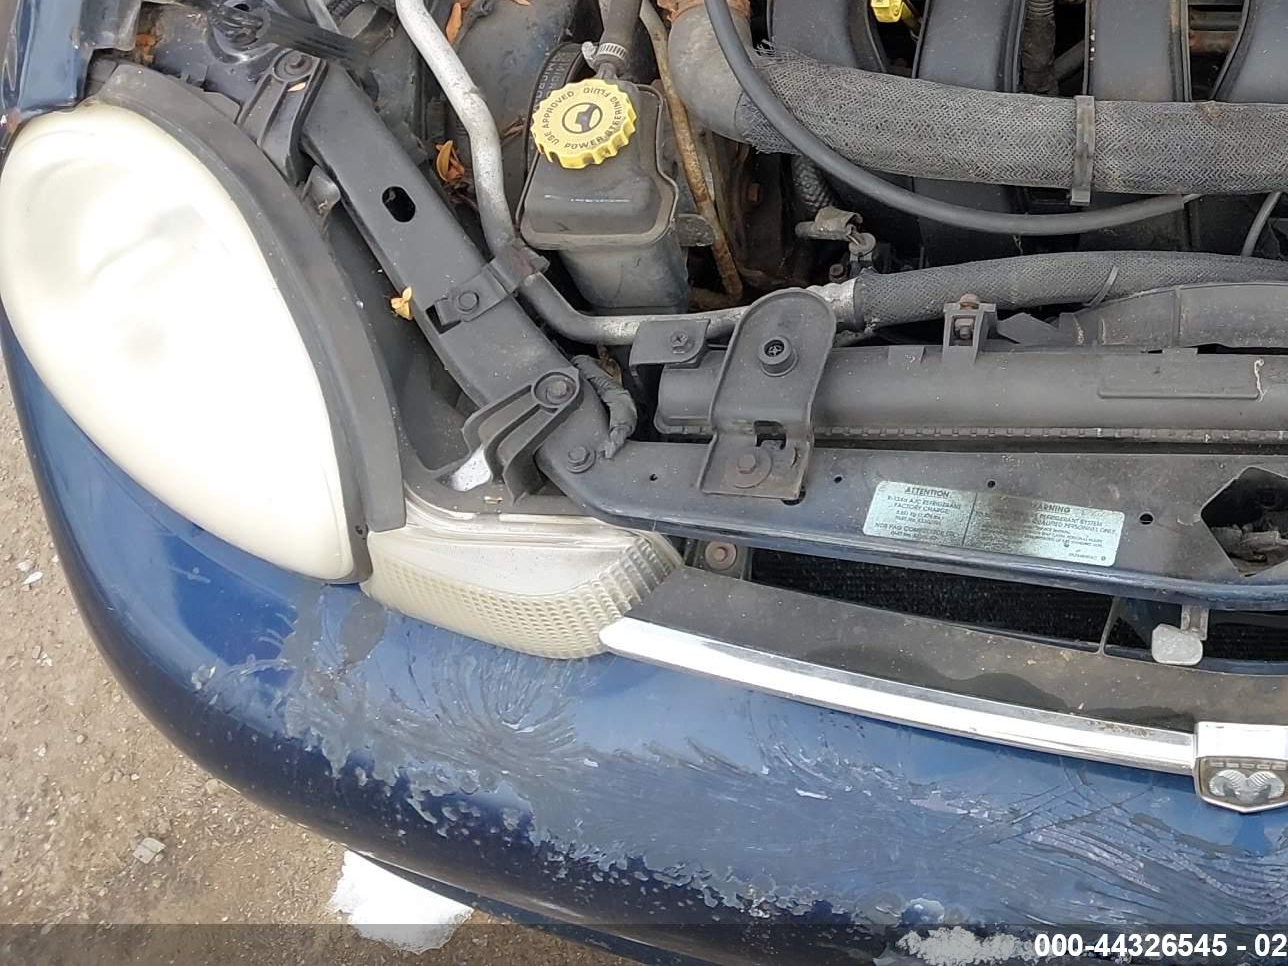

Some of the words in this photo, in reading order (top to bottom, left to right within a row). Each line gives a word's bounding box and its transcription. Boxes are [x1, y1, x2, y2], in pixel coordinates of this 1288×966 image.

[583, 86, 611, 98] FLUID
[542, 90, 575, 129] APPROVED
[604, 96, 624, 139] STEERING
[543, 130, 560, 146] USE
[564, 136, 605, 150] POWER
